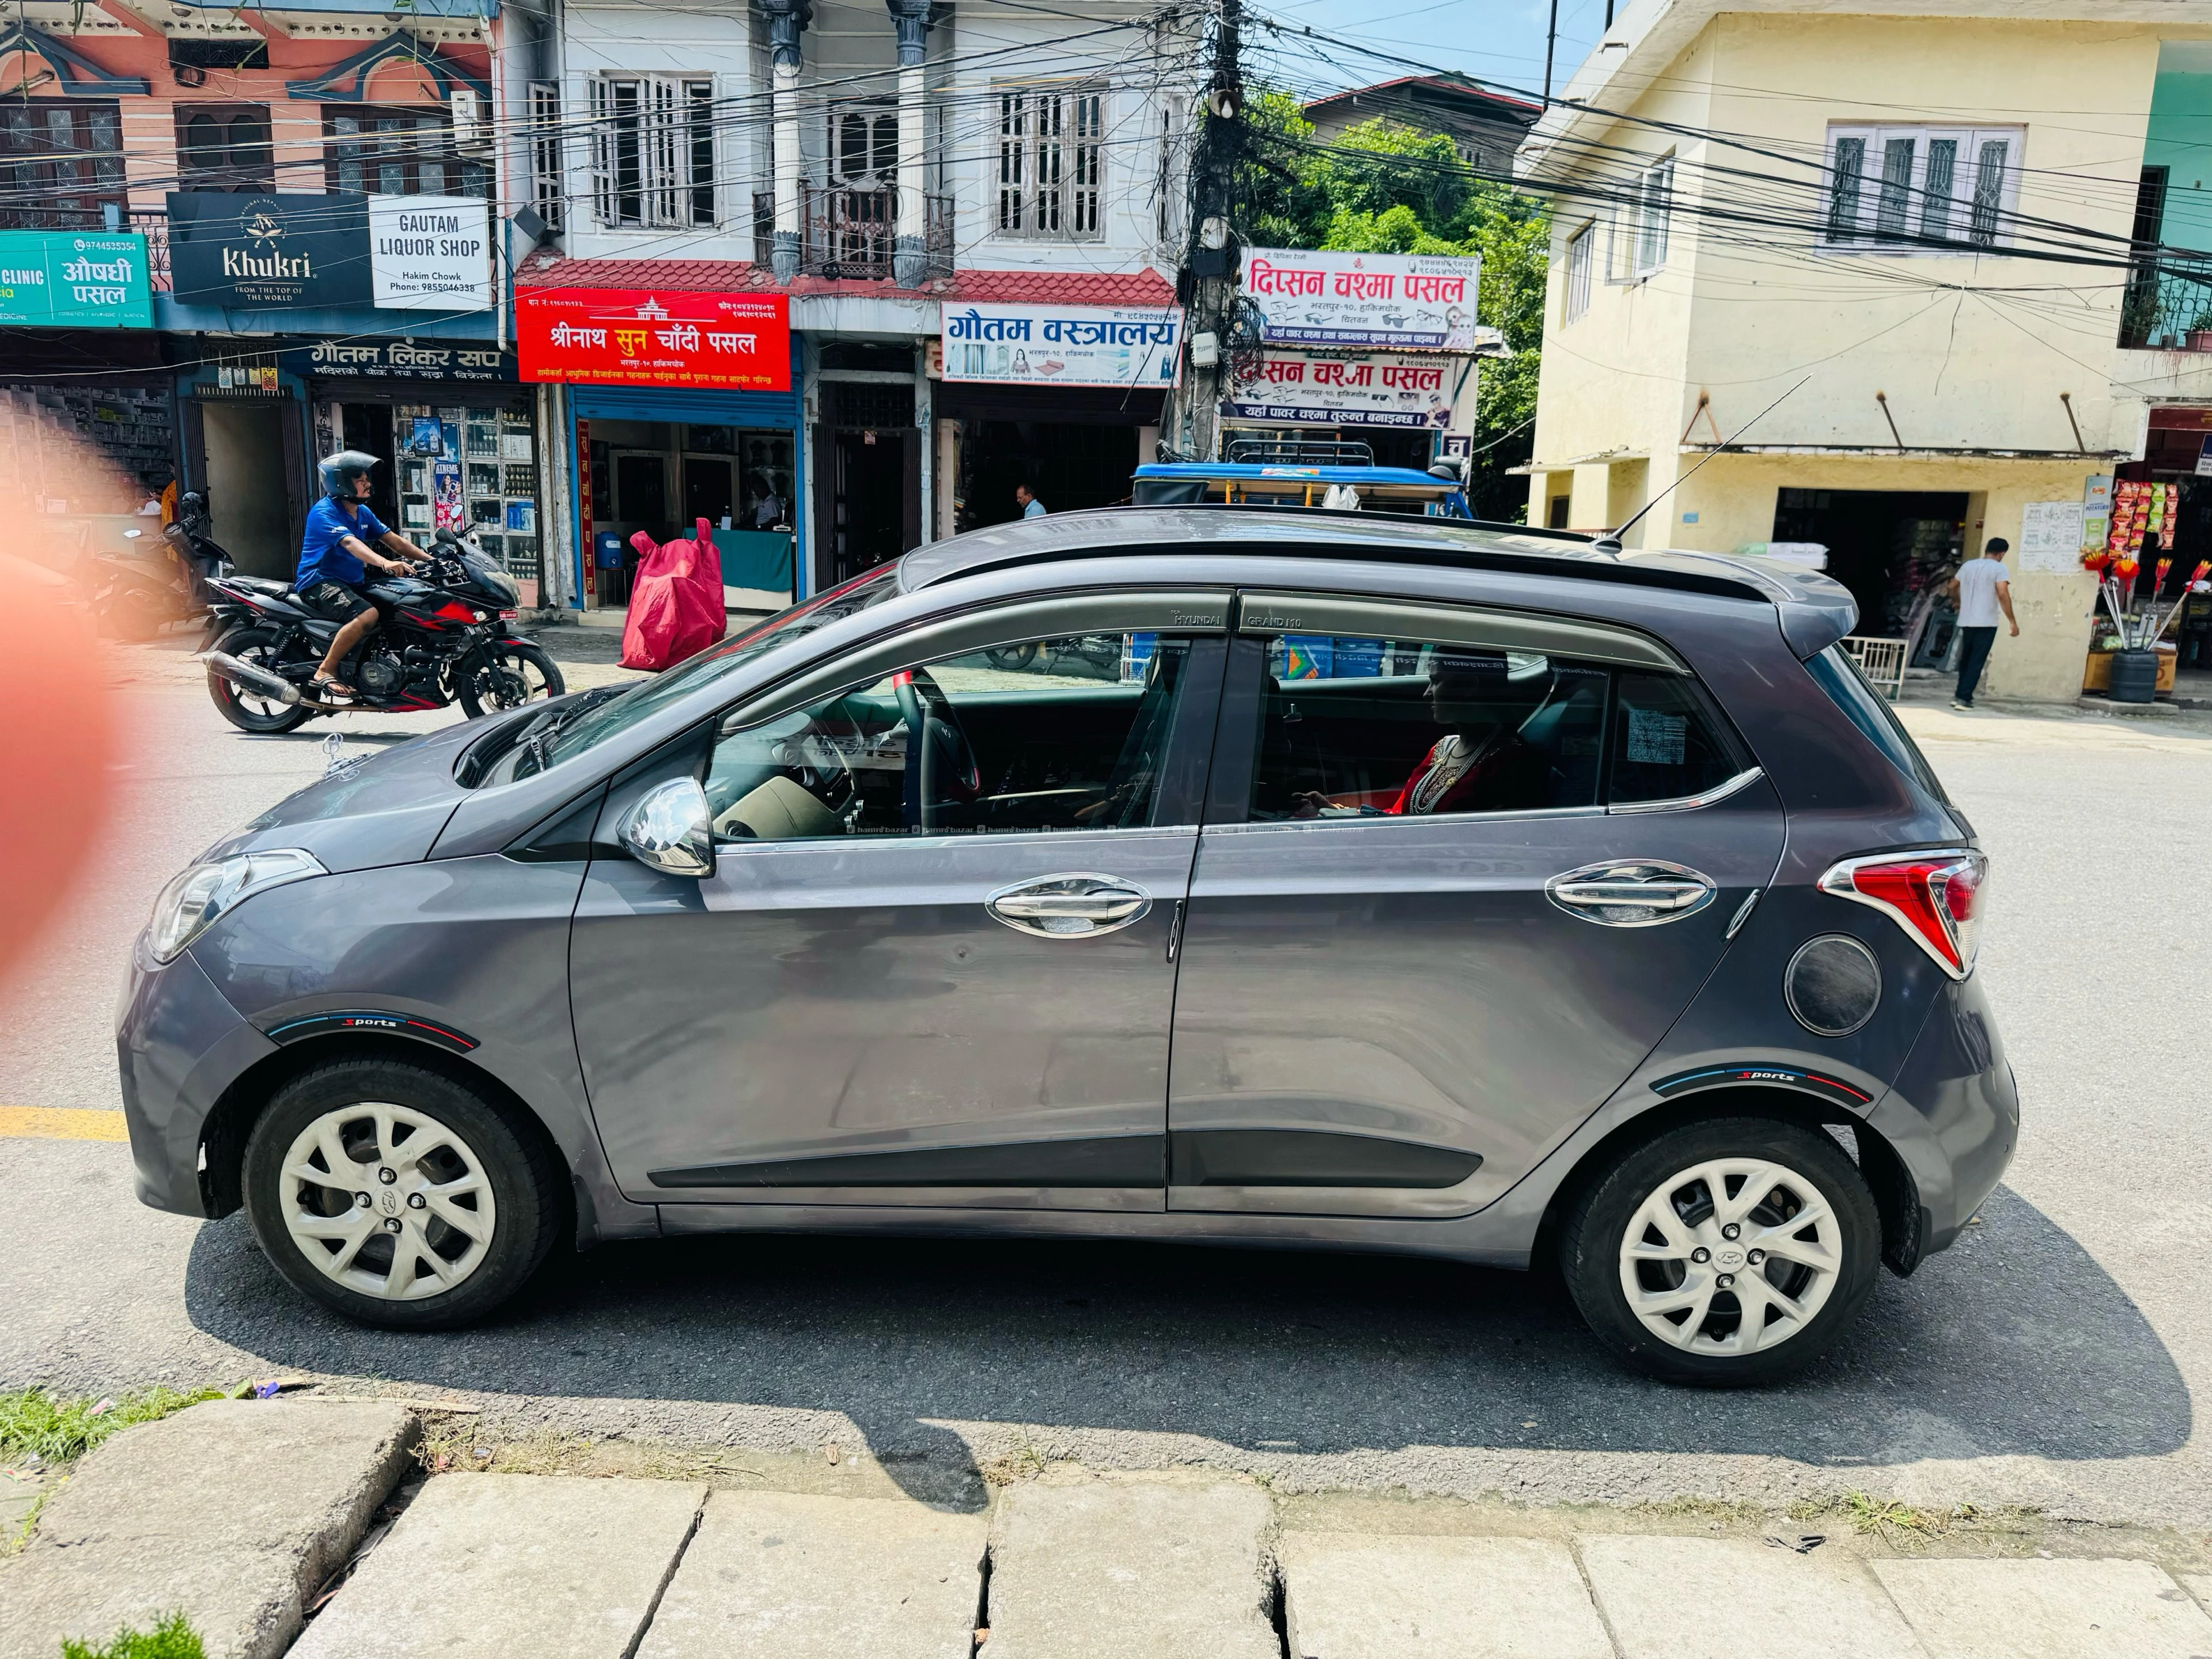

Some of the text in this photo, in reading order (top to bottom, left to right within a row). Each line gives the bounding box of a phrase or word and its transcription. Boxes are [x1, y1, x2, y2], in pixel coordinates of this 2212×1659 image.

[399, 215, 459, 233] GAUTAM
[86, 241, 136, 251] 9744535354
[380, 238, 480, 257] LIQUOR SHOP
[61, 256, 132, 282] औषधी
[223, 247, 311, 278] Khukri
[2, 270, 44, 285] CLINIC
[403, 272, 461, 281] Hakim Chowk
[1250, 259, 1465, 304] दिप्सन चश्मा पसल
[73, 286, 126, 305] पसल
[422, 283, 475, 292] 9855046338
[948, 309, 1176, 346] गौतम वस्त्रालय
[1286, 330, 1302, 338] पावर
[1323, 331, 1336, 339] तथा
[550, 321, 757, 357] श्रीनाथ सुन चाँदी पसल
[309, 339, 380, 363] गौतम
[457, 350, 502, 367] सप
[711, 375, 726, 383] गहना
[1382, 366, 1444, 391] पसल
[1270, 408, 1296, 418] पावर
[1299, 410, 1328, 420] चश्मा
[435, 464, 459, 474] XTREME
[1175, 616, 1220, 626] HYUNDAI
[1248, 617, 1284, 627] GRAND
